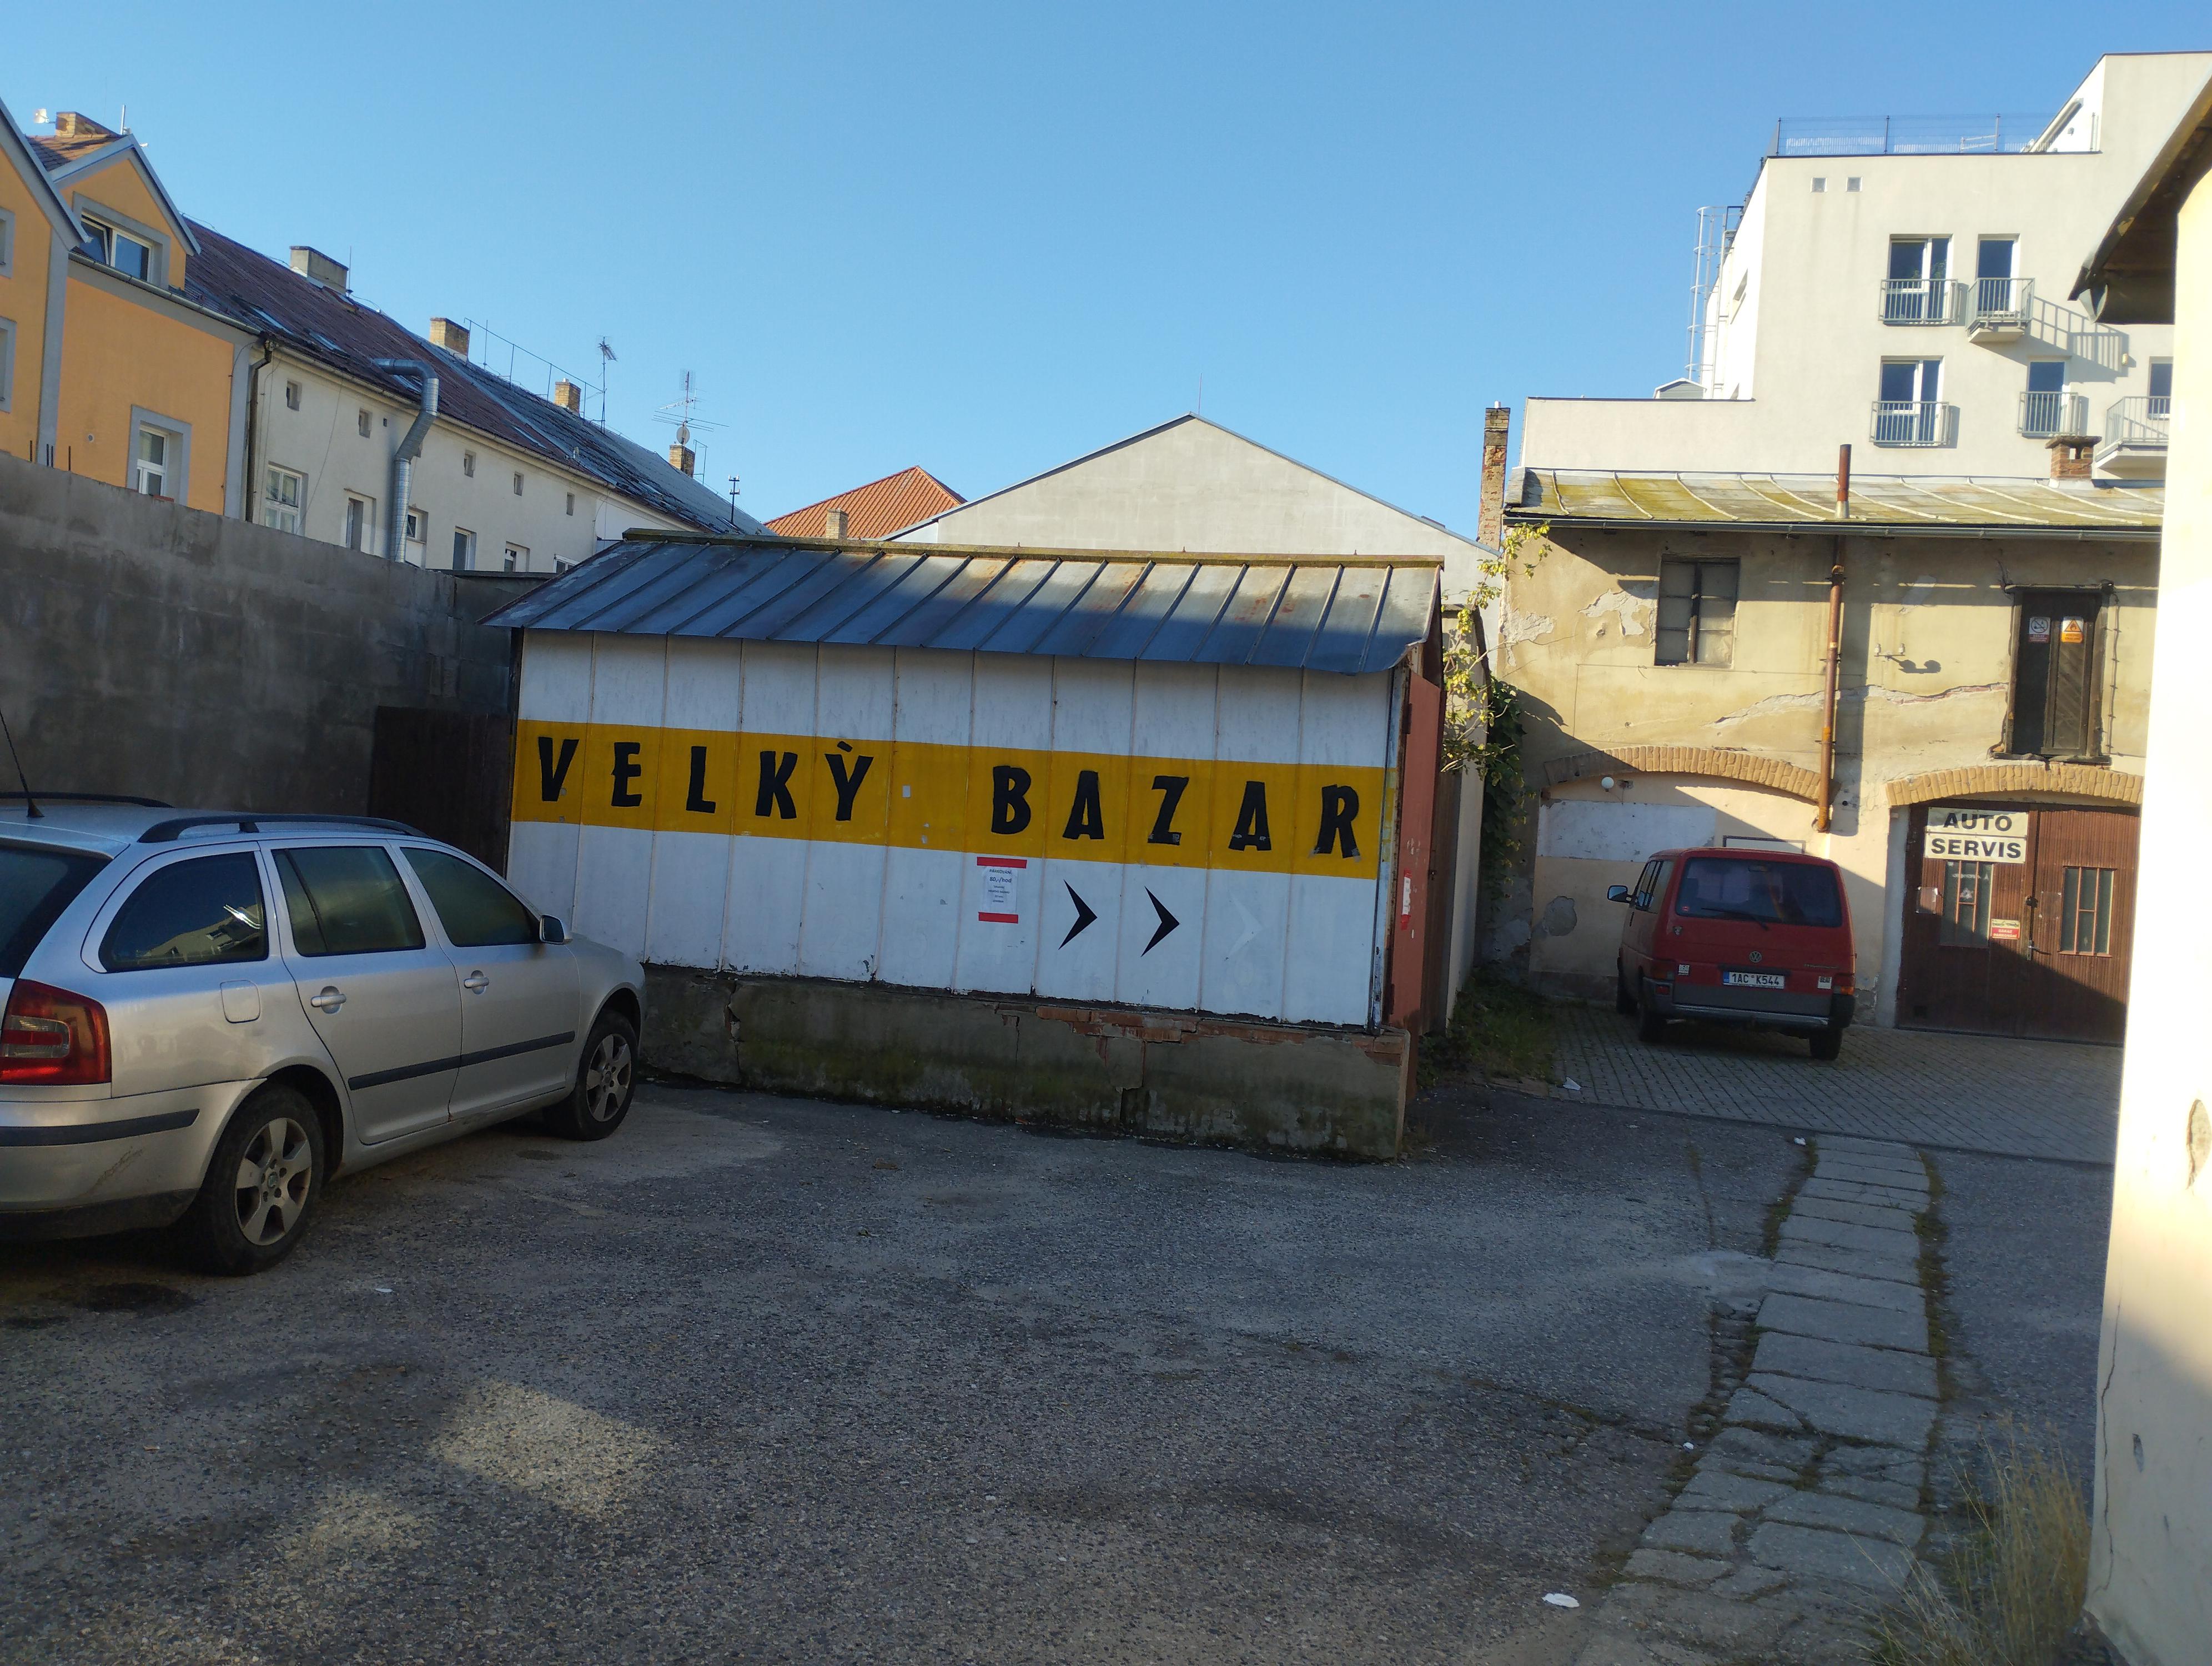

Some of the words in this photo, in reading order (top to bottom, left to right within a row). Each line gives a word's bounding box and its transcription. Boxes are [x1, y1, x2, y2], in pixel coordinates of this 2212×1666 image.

[991, 765, 1360, 859] BAZAR
[1943, 812, 2013, 832] AUTO
[1931, 837, 2022, 859] SERVIS
[1732, 973, 1749, 983] 1AC
[1756, 975, 1780, 986] K544
